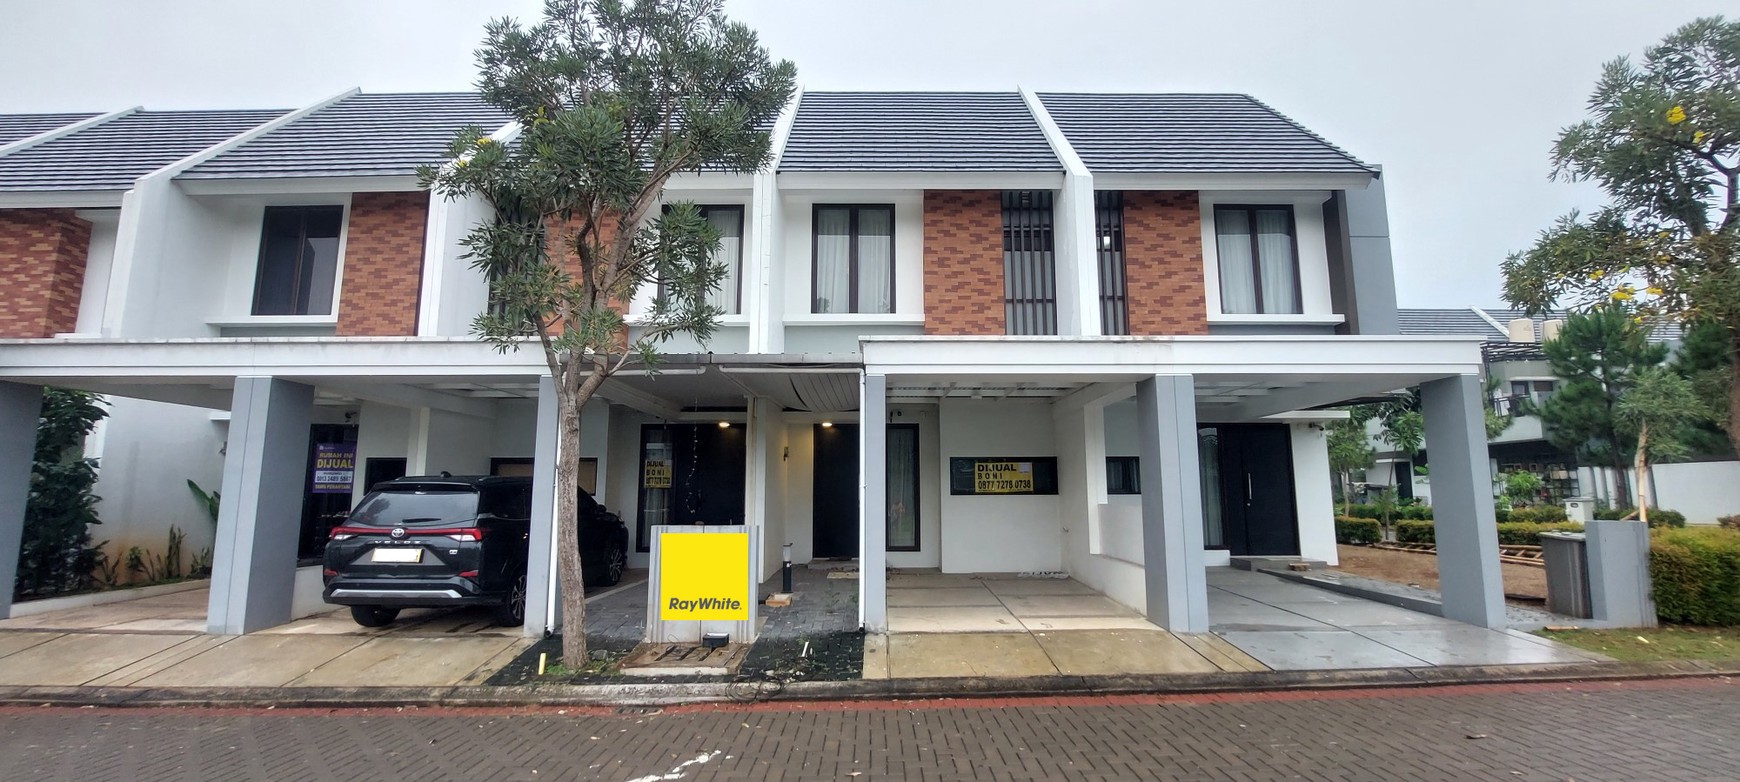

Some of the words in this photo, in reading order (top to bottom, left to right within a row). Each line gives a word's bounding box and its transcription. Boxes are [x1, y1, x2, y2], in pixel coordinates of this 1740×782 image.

[316, 459, 354, 468] DIJUAL
[977, 464, 1017, 472] DIJUAL
[978, 480, 995, 490] 0877
[996, 480, 1013, 489] 7278
[1014, 479, 1031, 489] 0738
